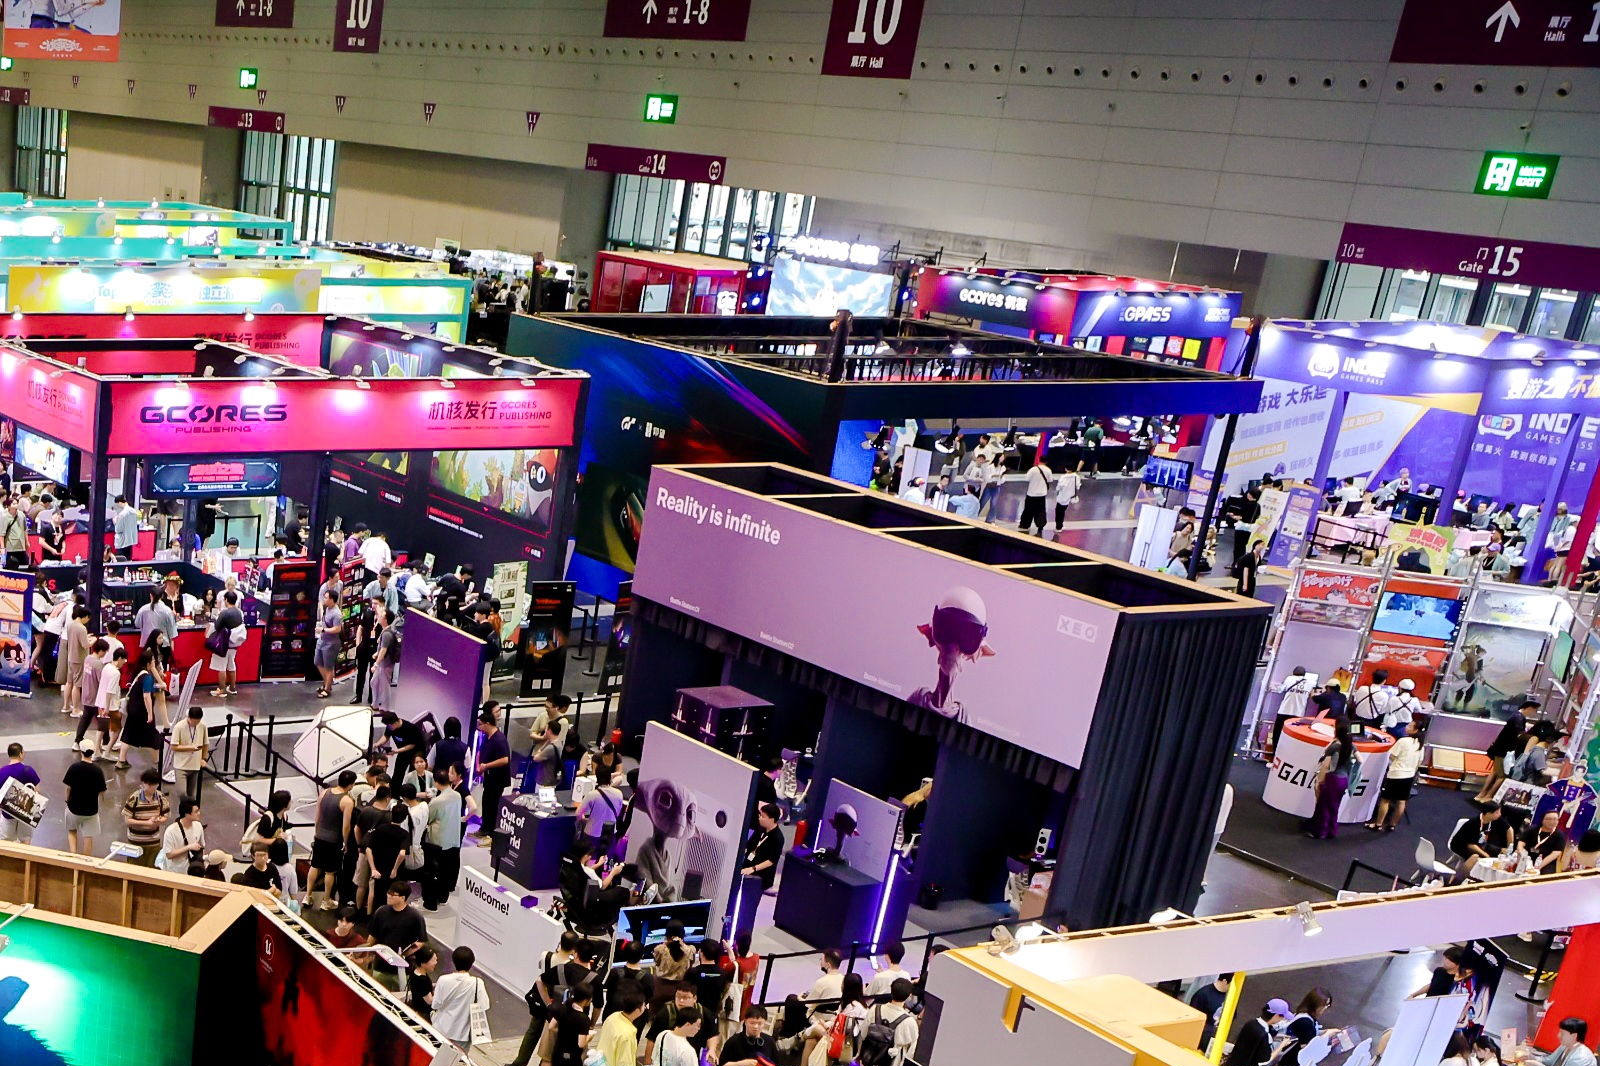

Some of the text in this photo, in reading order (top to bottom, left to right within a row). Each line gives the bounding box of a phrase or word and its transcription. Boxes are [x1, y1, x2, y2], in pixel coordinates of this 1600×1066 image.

[683, 0, 709, 25] 1-8
[847, 0, 902, 46] 10
[1543, 31, 1566, 42] Halls
[244, 112, 253, 128] 13
[651, 154, 666, 175] 14
[1458, 245, 1523, 277] Gate 15
[1124, 305, 1173, 322] GPASS
[254, 332, 287, 342] GCORES
[254, 341, 301, 350] PUBLISHING
[1339, 372, 1366, 383] GAMES
[26, 379, 58, 408] 机核发行
[139, 403, 289, 424] GCORES
[428, 400, 538, 421] 机核发行 GCORES
[499, 411, 552, 421] PUBLISHING
[175, 426, 252, 435] PUBLISHING
[1528, 413, 1600, 441] INDE
[1524, 431, 1561, 445] GAMES
[1509, 449, 1587, 473] 找到你的游之星
[655, 485, 781, 547] Reality is infinite
[500, 806, 526, 829] Out of
[500, 818, 515, 836] this
[465, 876, 510, 916] Welcome!
